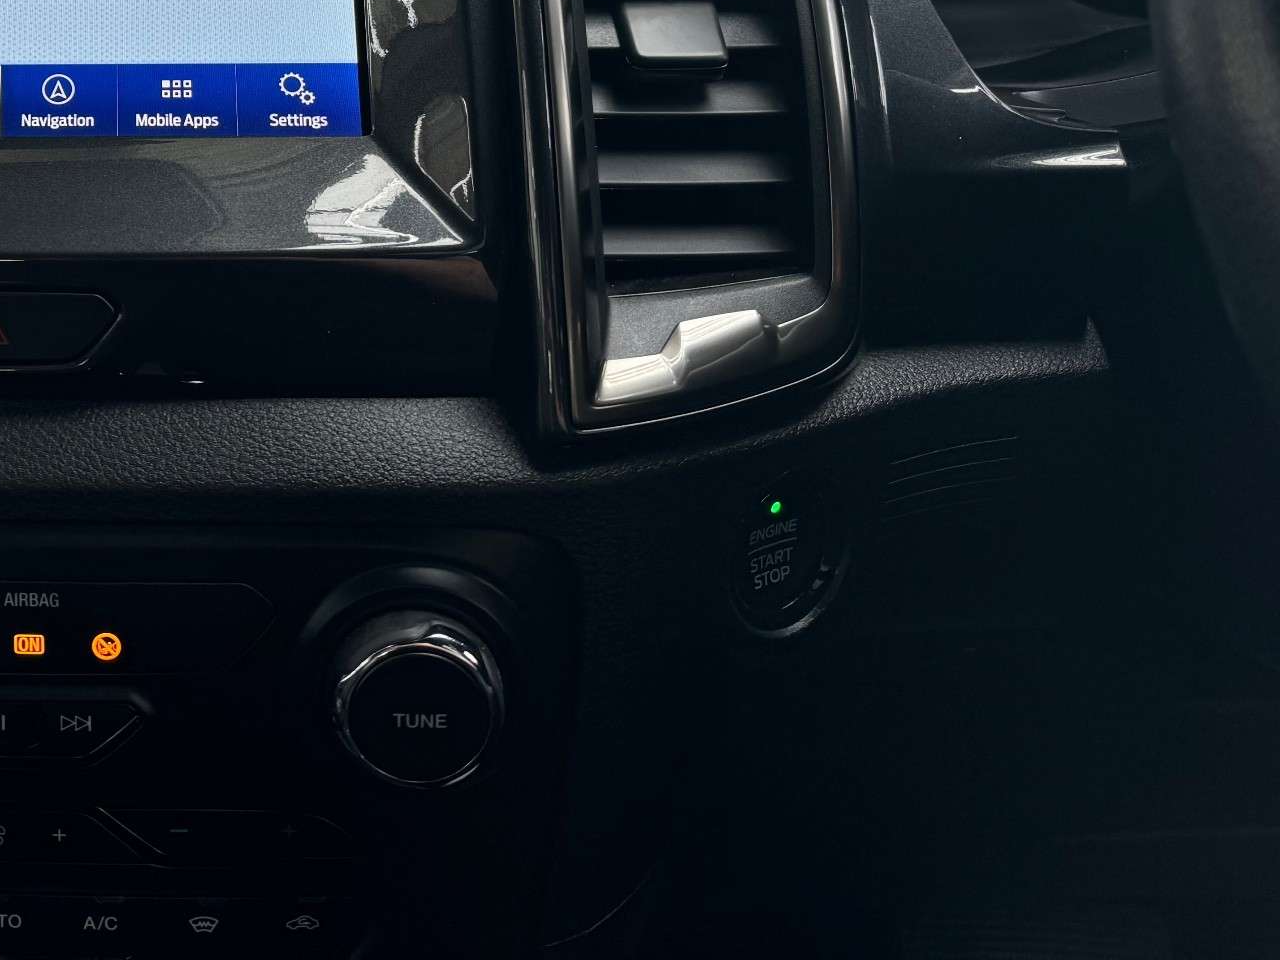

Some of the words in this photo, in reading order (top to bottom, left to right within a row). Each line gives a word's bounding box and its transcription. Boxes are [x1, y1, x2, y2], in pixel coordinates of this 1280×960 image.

[20, 113, 95, 129] Navigation
[135, 113, 182, 128] Mobile
[183, 114, 219, 129] Apps
[269, 113, 328, 129] Settings
[749, 519, 798, 545] ENGINE
[749, 546, 794, 574] START
[753, 565, 791, 590] STOP
[3, 592, 60, 608] AIRBAG
[17, 637, 41, 652] ON
[391, 713, 449, 728] TUNE
[82, 915, 119, 931] A/C
